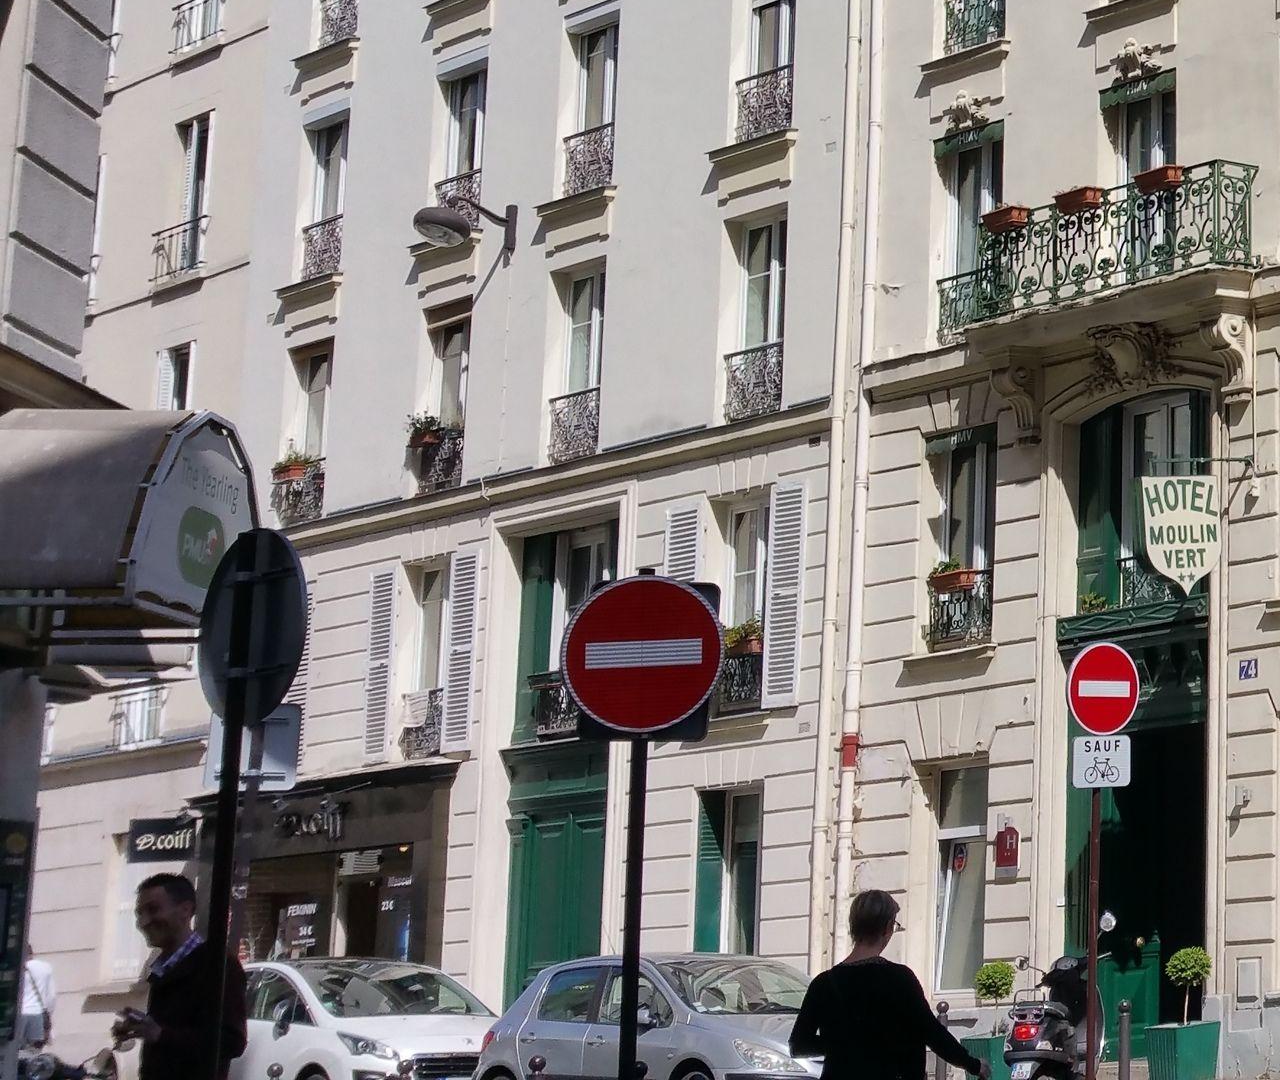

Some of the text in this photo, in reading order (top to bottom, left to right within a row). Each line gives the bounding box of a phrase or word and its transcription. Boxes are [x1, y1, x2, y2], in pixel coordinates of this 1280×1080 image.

[950, 429, 973, 445] HMV
[202, 469, 239, 514] Yearling
[1144, 479, 1218, 518] HOTEL
[1149, 524, 1218, 545] MOULIN
[1163, 548, 1206, 569] VERT
[1240, 660, 1256, 679] 74
[1084, 740, 1121, 752] SAUF
[1006, 834, 1017, 850] H
